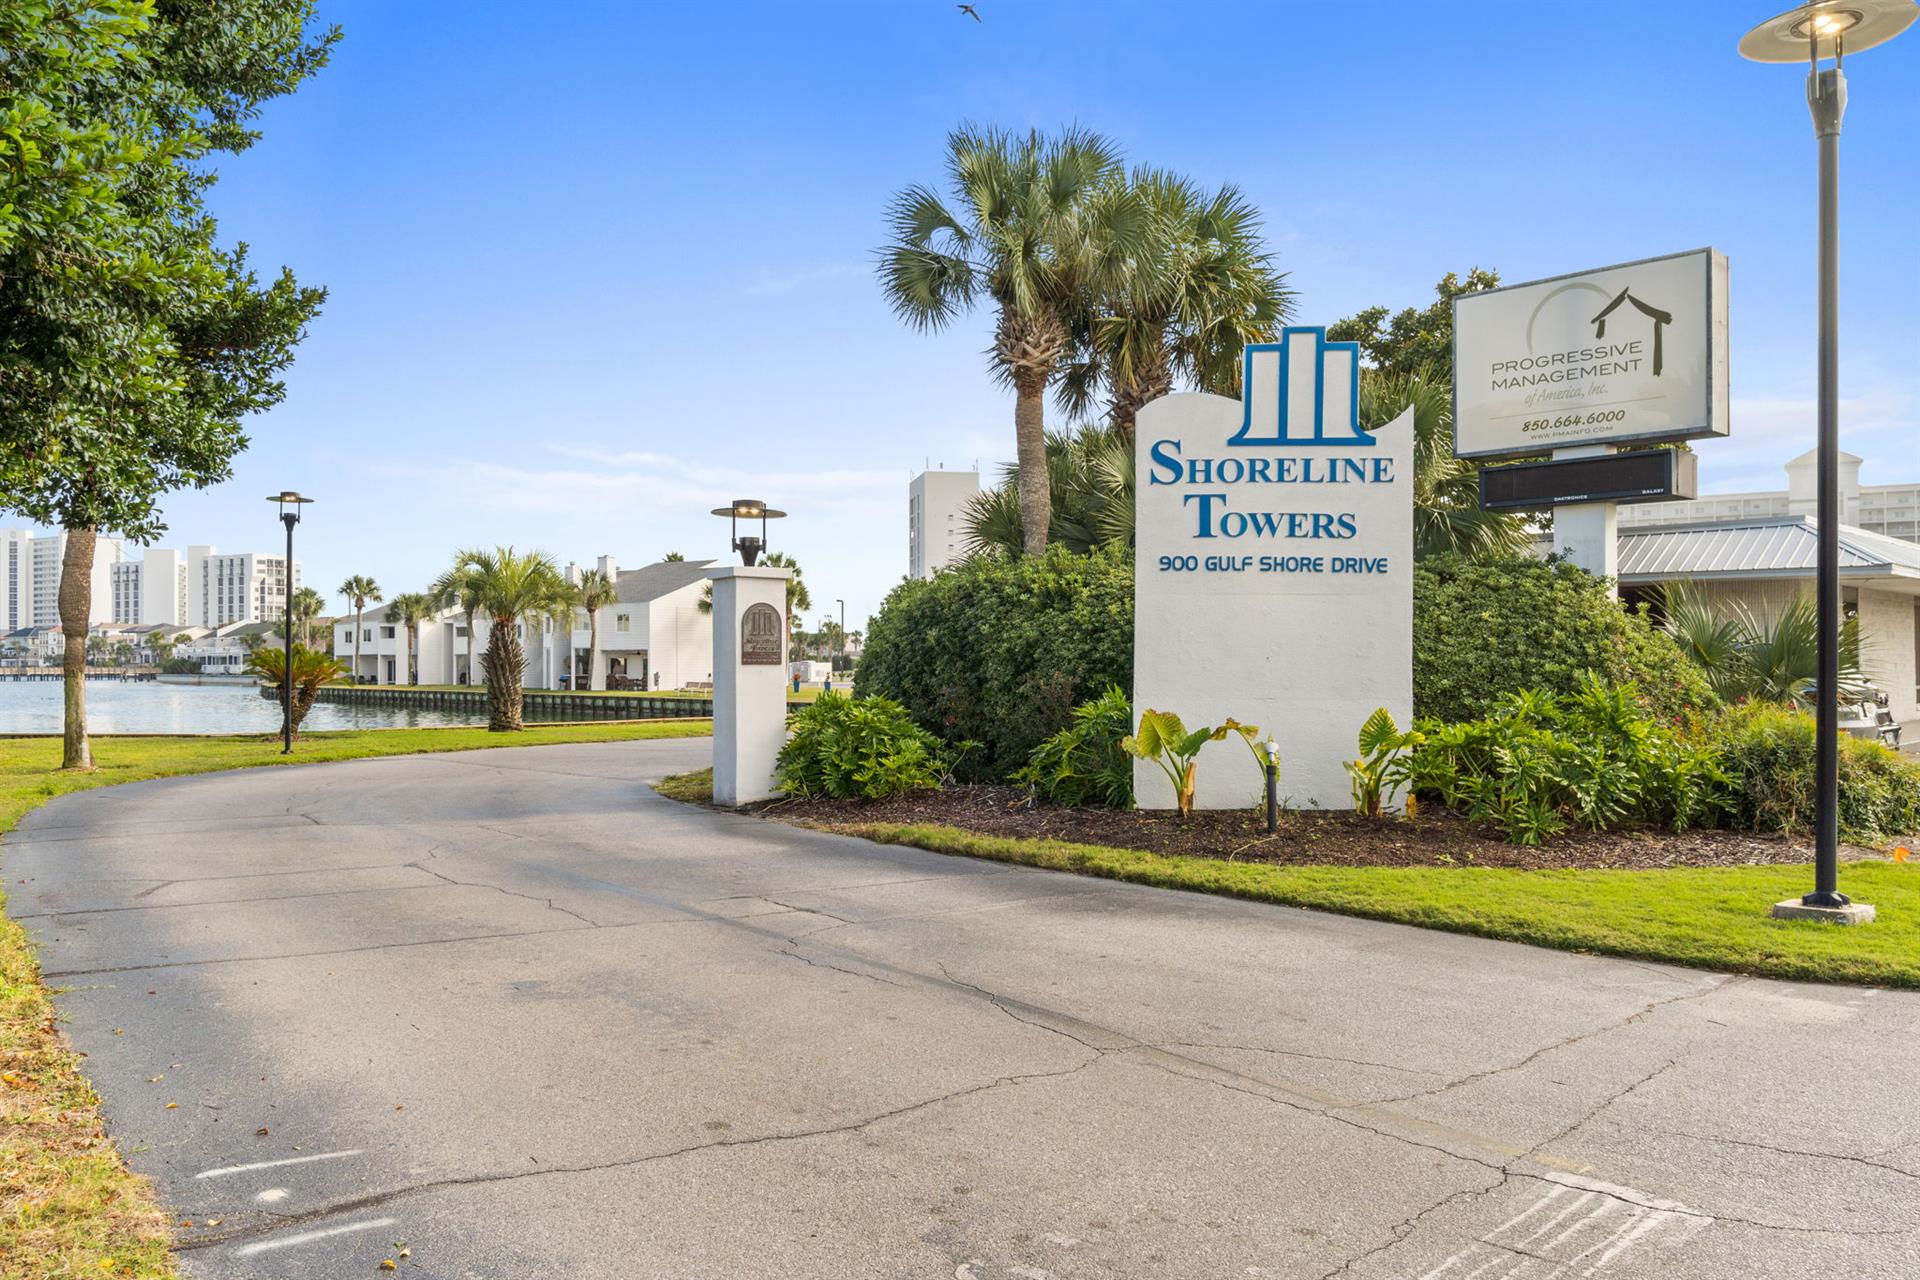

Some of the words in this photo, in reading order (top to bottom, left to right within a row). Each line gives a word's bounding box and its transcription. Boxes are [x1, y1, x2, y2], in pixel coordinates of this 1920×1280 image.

[1491, 340, 1643, 375] PROGRESSIVE
[1491, 358, 1643, 392] MANAGEMENT
[1523, 391, 1537, 408] of
[1588, 382, 1609, 397] Inc.
[1521, 409, 1626, 433] 850.664.6000
[1150, 439, 1395, 486] SHORELINE
[1183, 493, 1357, 540] TOWERS
[1159, 555, 1198, 572] 900
[1205, 555, 1254, 572] GULF
[1259, 556, 1324, 573] SHORE
[1331, 556, 1388, 574] DRIVE
